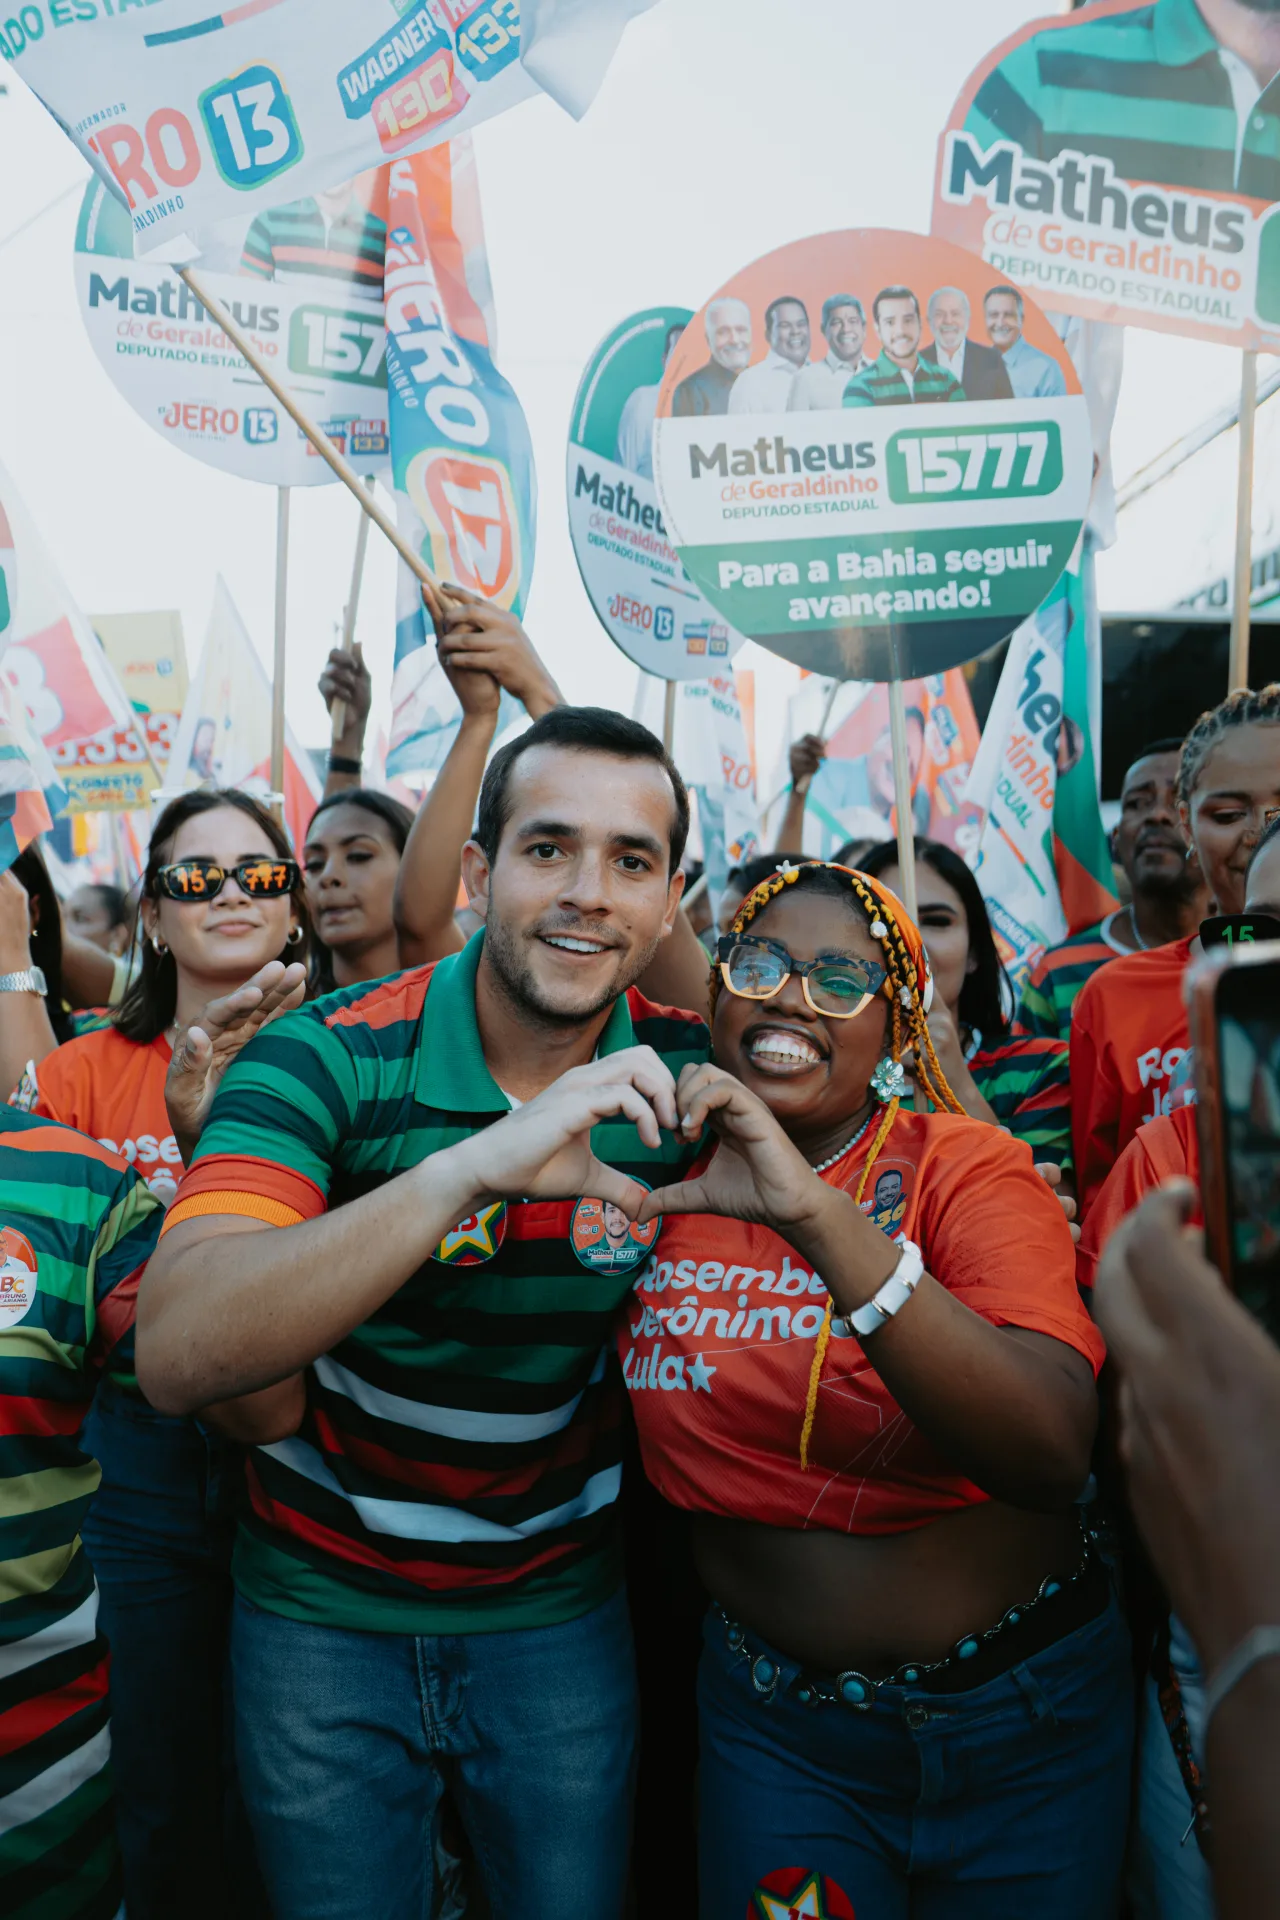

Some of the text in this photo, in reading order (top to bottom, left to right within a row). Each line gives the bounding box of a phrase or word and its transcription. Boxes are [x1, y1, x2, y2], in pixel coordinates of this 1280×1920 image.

[342, 9, 437, 102] WAGNER
[378, 59, 453, 137] 130
[88, 81, 290, 210] RO 13
[949, 137, 1246, 254] Matheus
[991, 216, 1242, 292] de Geraldinho
[988, 252, 1237, 320] DEPUTADO ESTADUAL
[117, 317, 144, 338] de
[116, 341, 198, 364] DEPUTADO
[163, 402, 239, 435] JERO
[248, 410, 275, 441] 13
[689, 431, 1049, 494] Matheus 15777
[721, 474, 879, 502] de Geraldinho
[722, 498, 879, 520] DEPUTADO ESTADUAL
[587, 532, 676, 578] DEPUTADO ESTADUAL
[718, 539, 1052, 590] Para a Bahia seguir
[610, 593, 653, 629] JERO
[788, 579, 991, 622] avançando!
[177, 865, 287, 893] 15 777
[588, 1248, 614, 1257] Matheus
[616, 1250, 636, 1259] 15777
[631, 1295, 825, 1341] Jerônimo
[623, 1343, 687, 1391] Lula
